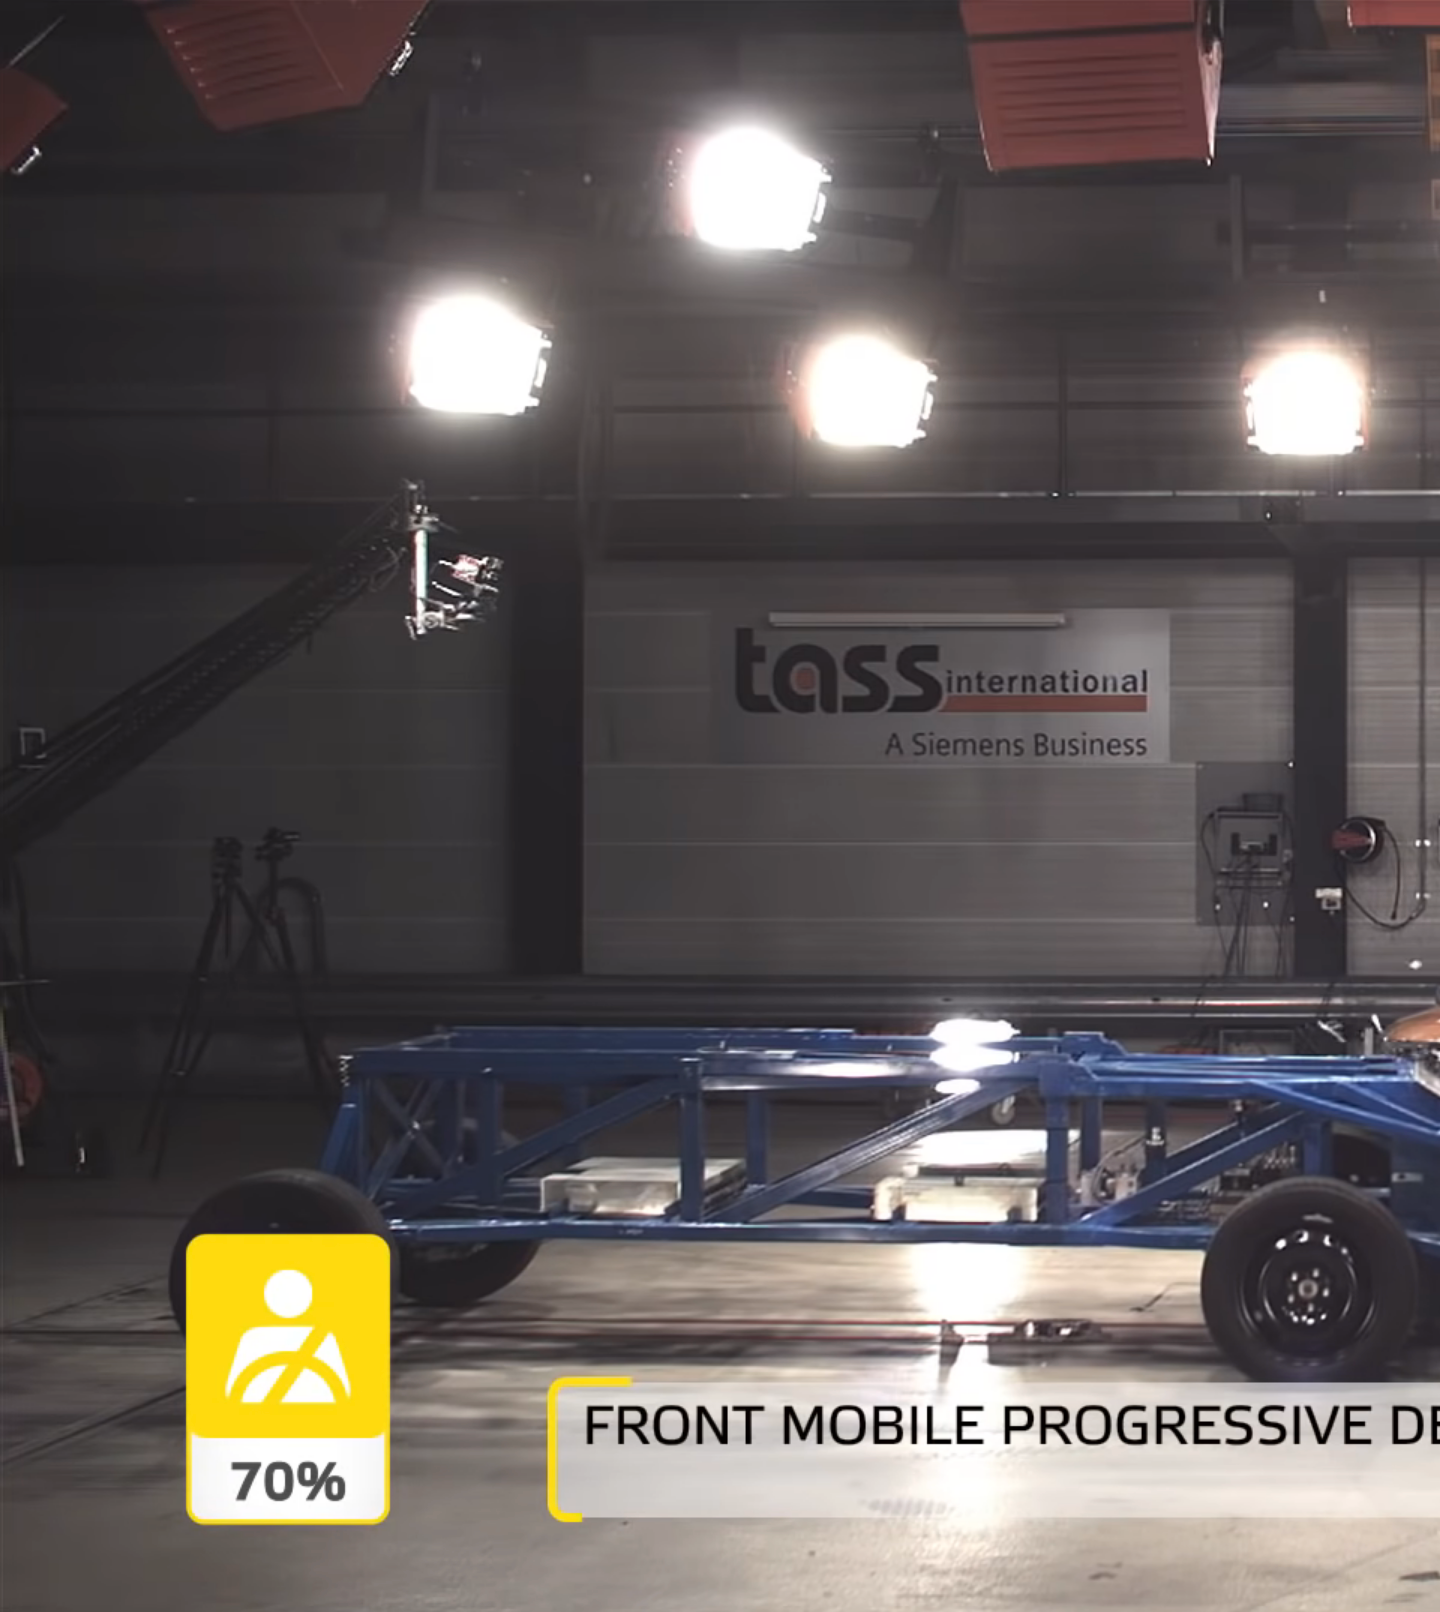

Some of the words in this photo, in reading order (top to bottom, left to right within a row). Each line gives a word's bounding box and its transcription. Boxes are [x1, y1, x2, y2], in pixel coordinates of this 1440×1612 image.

[735, 627, 944, 714] tass
[945, 669, 1147, 694] international
[885, 732, 905, 757] A
[911, 731, 1026, 757] Siemens
[1033, 732, 1148, 757] Business
